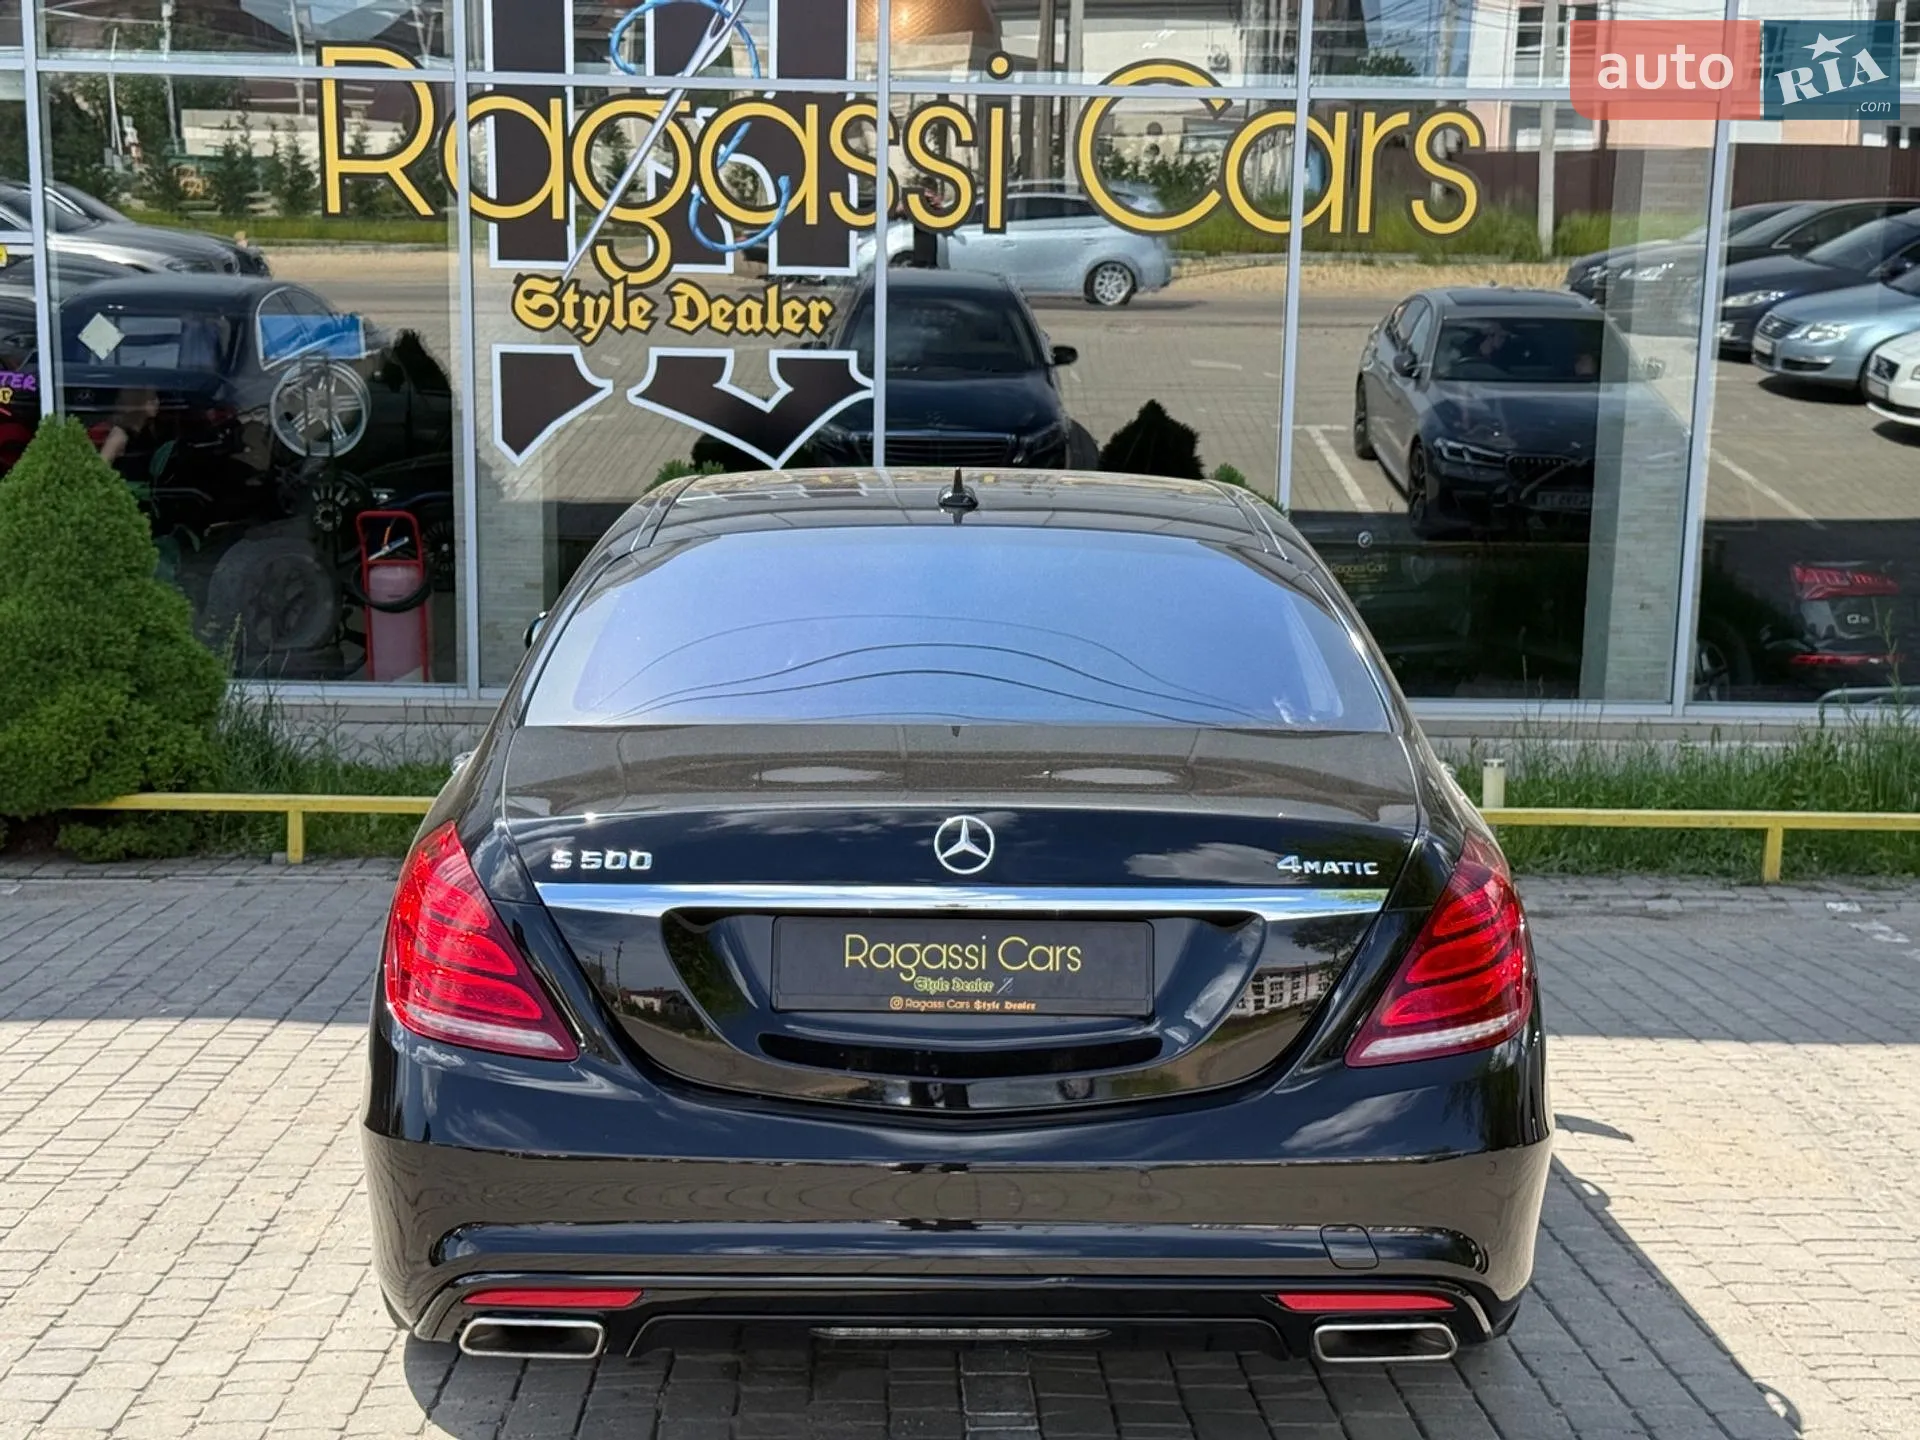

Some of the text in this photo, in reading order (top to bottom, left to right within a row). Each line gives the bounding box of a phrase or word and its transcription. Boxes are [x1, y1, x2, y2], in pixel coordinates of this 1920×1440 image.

[319, 43, 1484, 284] Ragassi Cars
[513, 276, 832, 344] Style Dealer
[550, 848, 652, 870] S 500
[1277, 855, 1379, 875] 4MATIC
[844, 934, 1082, 981] Ragassi Cars
[913, 976, 994, 995] Style Dealer
[946, 999, 971, 1010] Cars
